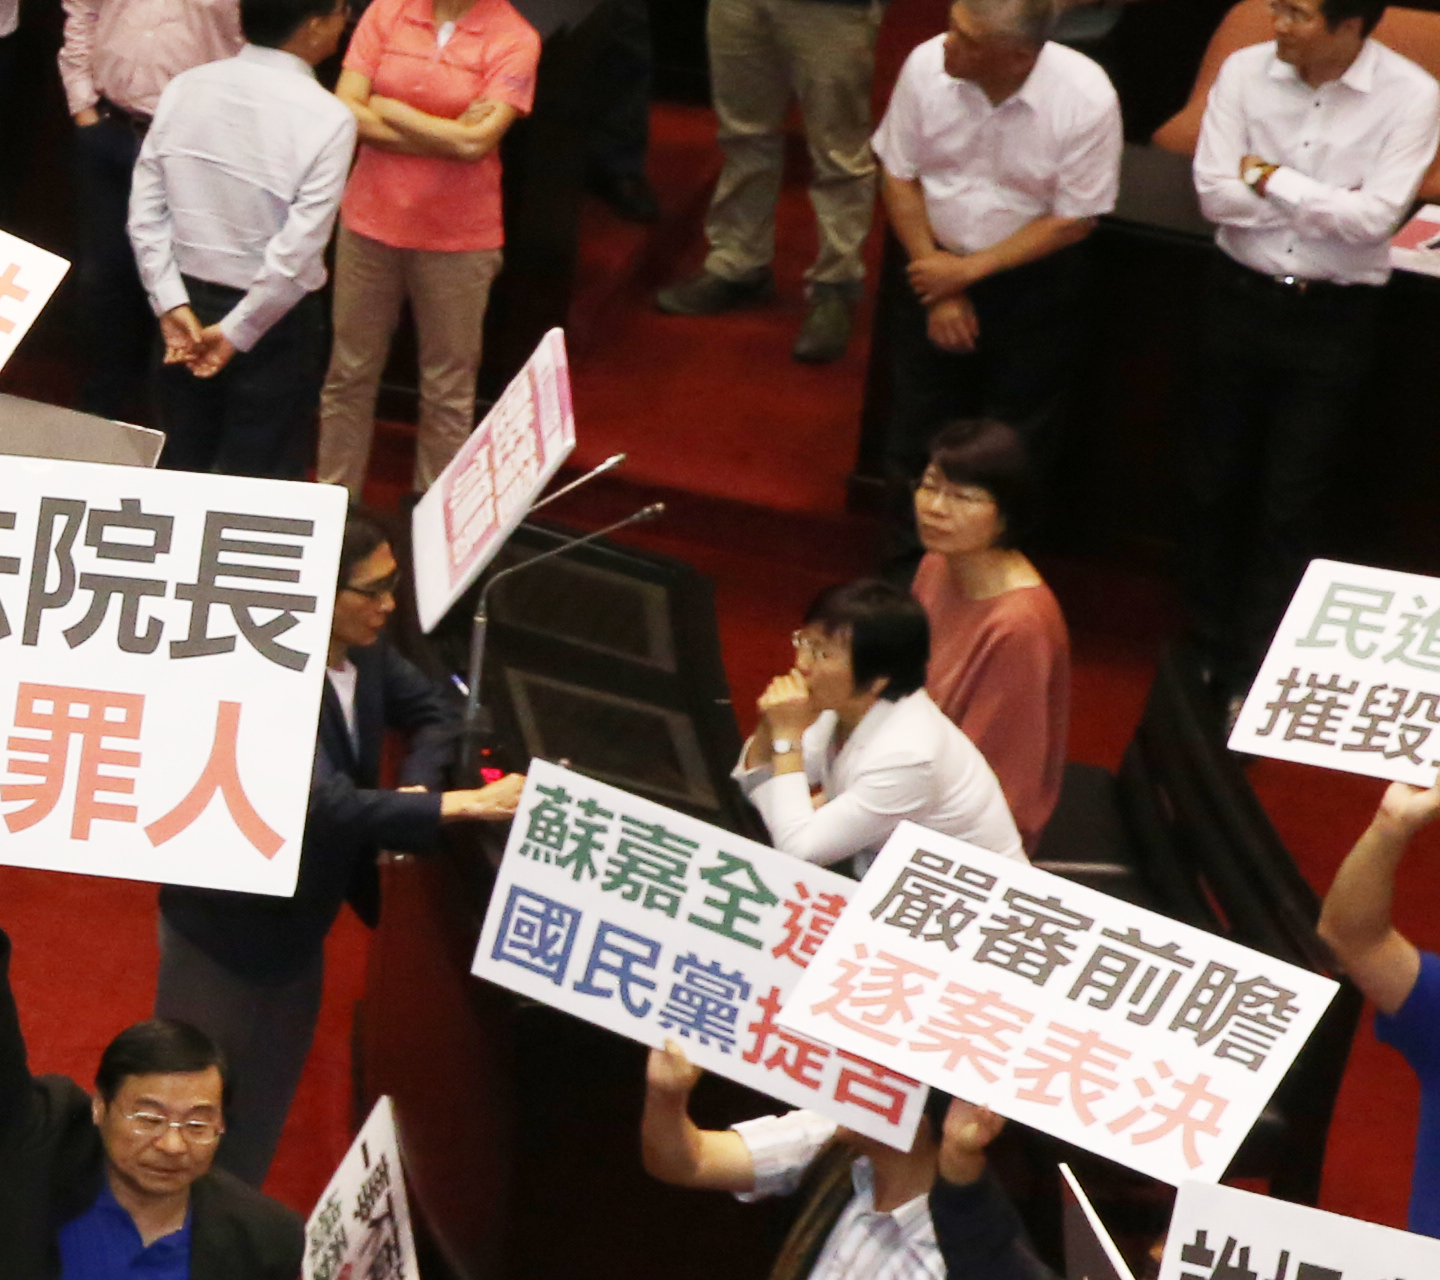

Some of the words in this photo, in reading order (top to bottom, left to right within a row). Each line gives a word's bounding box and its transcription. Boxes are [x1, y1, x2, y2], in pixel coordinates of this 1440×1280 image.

[808, 943, 1233, 1171] 逐案表決
[869, 847, 1303, 1073] 嚴審前瞻
